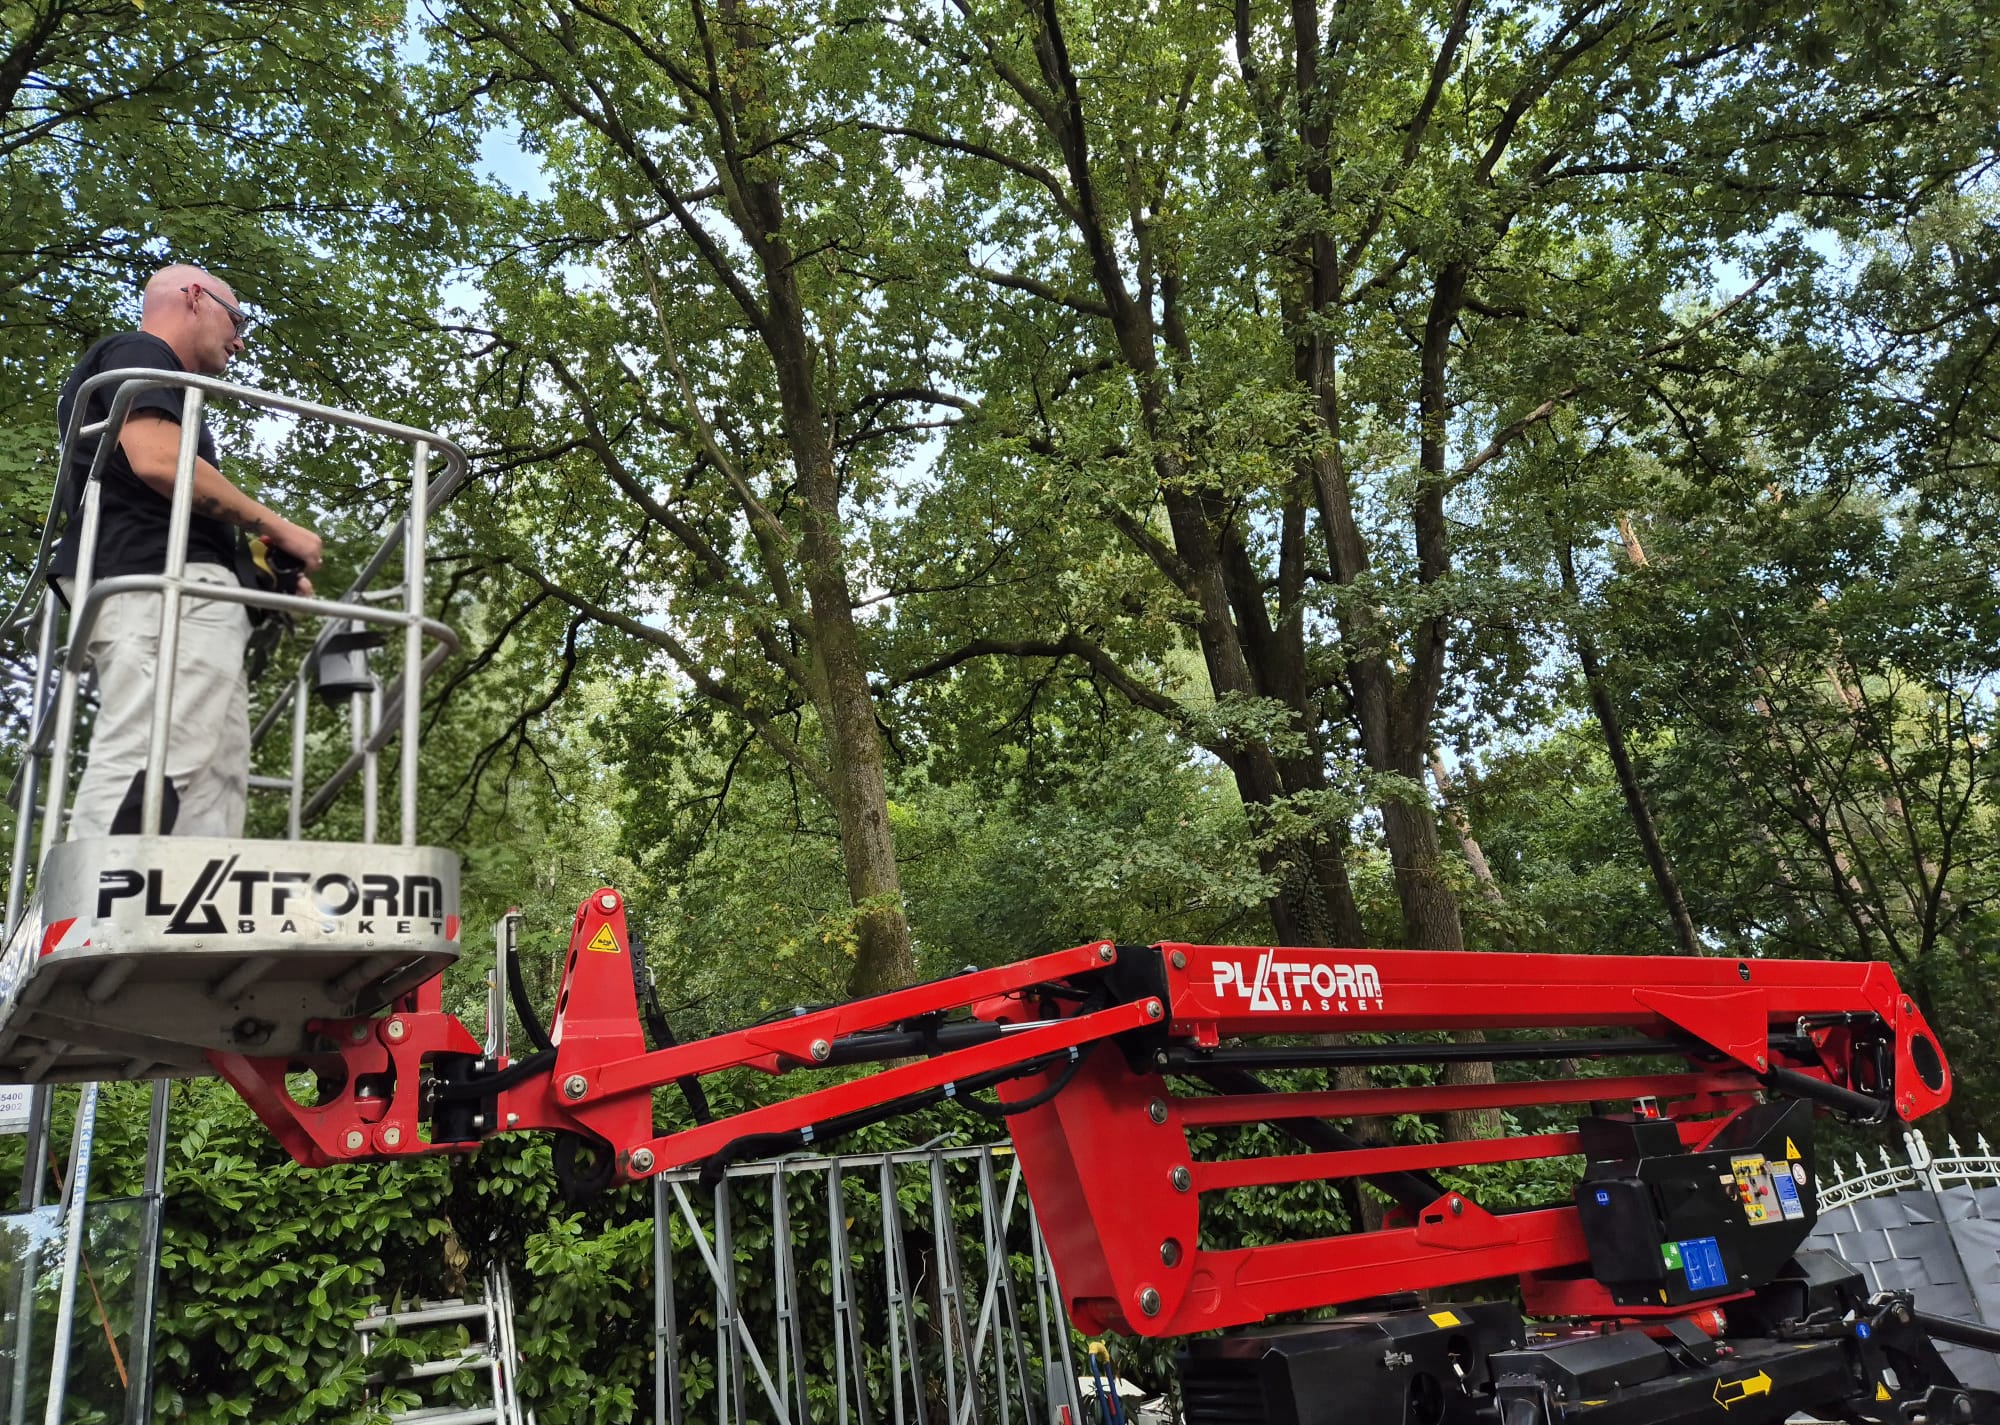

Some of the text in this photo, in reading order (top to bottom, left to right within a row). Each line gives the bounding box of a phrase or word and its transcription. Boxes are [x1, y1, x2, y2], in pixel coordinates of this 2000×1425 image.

[97, 854, 443, 935] PLATFORM
[237, 920, 443, 935] BASKET
[1211, 948, 1383, 1011] PLATFORM
[1281, 999, 1384, 1012] BASKET
